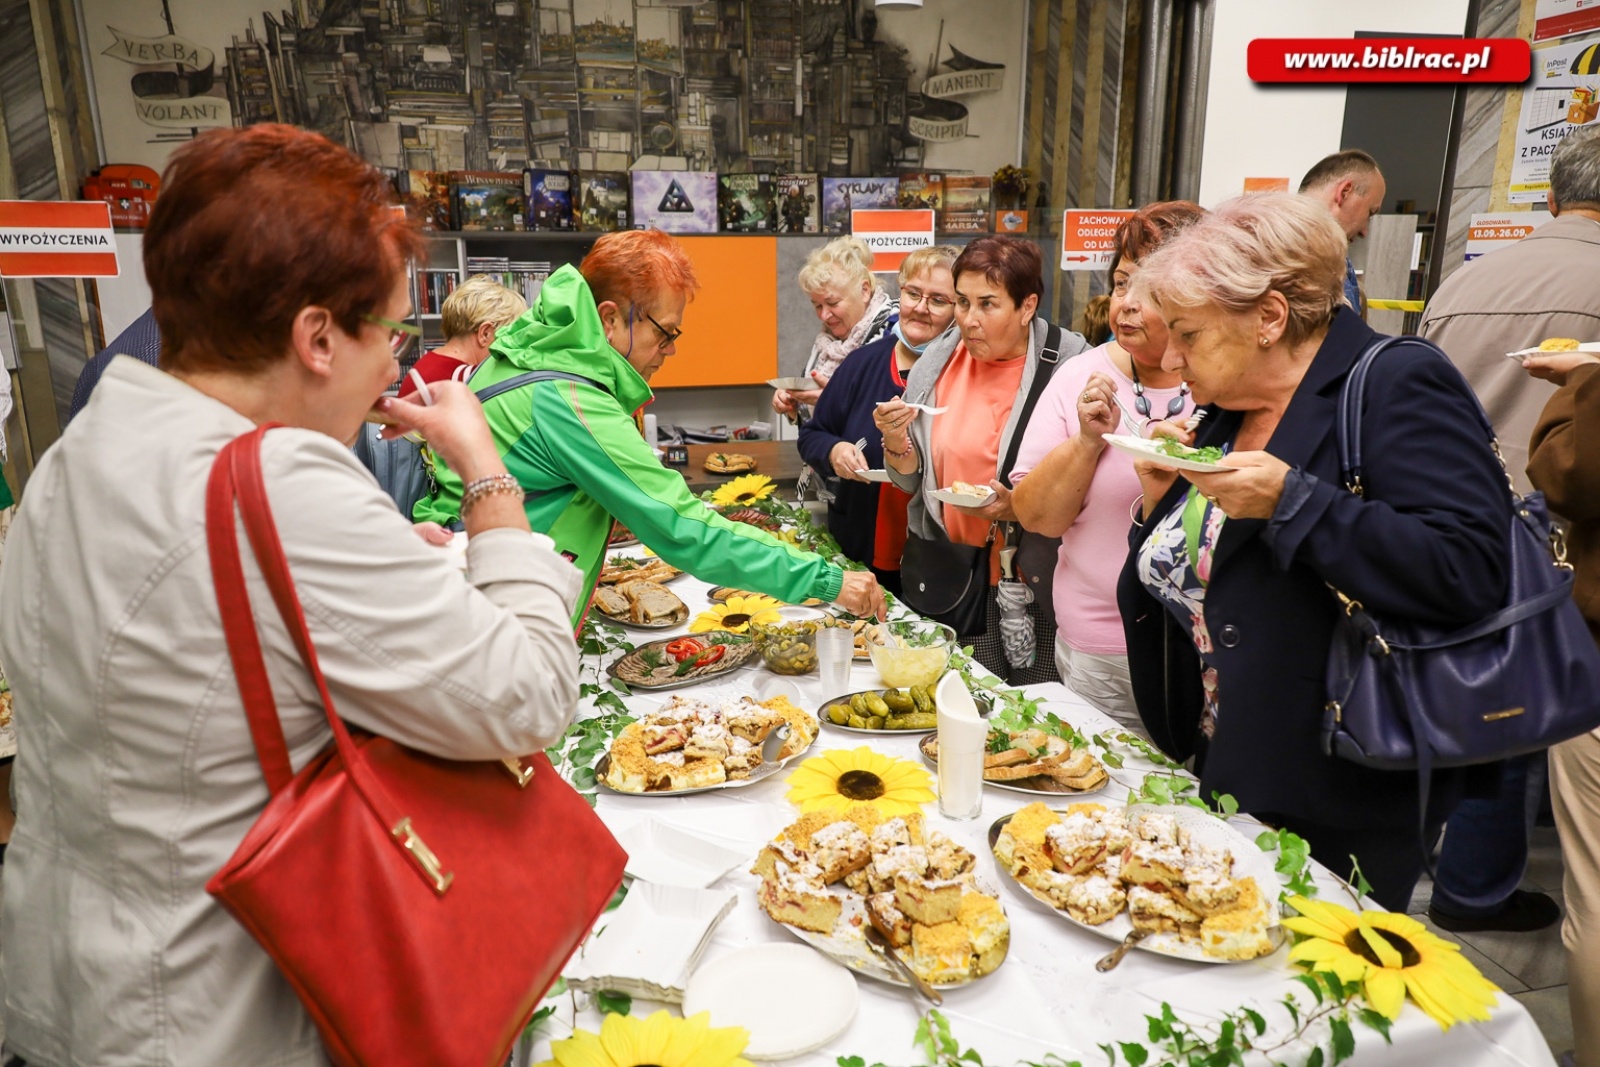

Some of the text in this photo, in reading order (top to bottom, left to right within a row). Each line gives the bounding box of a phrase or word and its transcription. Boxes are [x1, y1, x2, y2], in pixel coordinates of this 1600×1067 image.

[123, 40, 199, 65] VERBA
[1547, 58, 1567, 68] InPost
[932, 72, 995, 95] MANENT
[138, 104, 222, 120] VOLANT
[910, 120, 965, 139] SCRIPTA
[1521, 144, 1556, 158] Z PACZ
[837, 182, 885, 194] CYKLADY
[0, 232, 108, 246] WYPOŻYCZENIA
[1077, 228, 1116, 237] ODLEGŁO
[864, 235, 929, 247] YPOŻYCZENIA
[1083, 240, 1114, 249] OD LAD
[1093, 253, 1110, 263] 1 m
